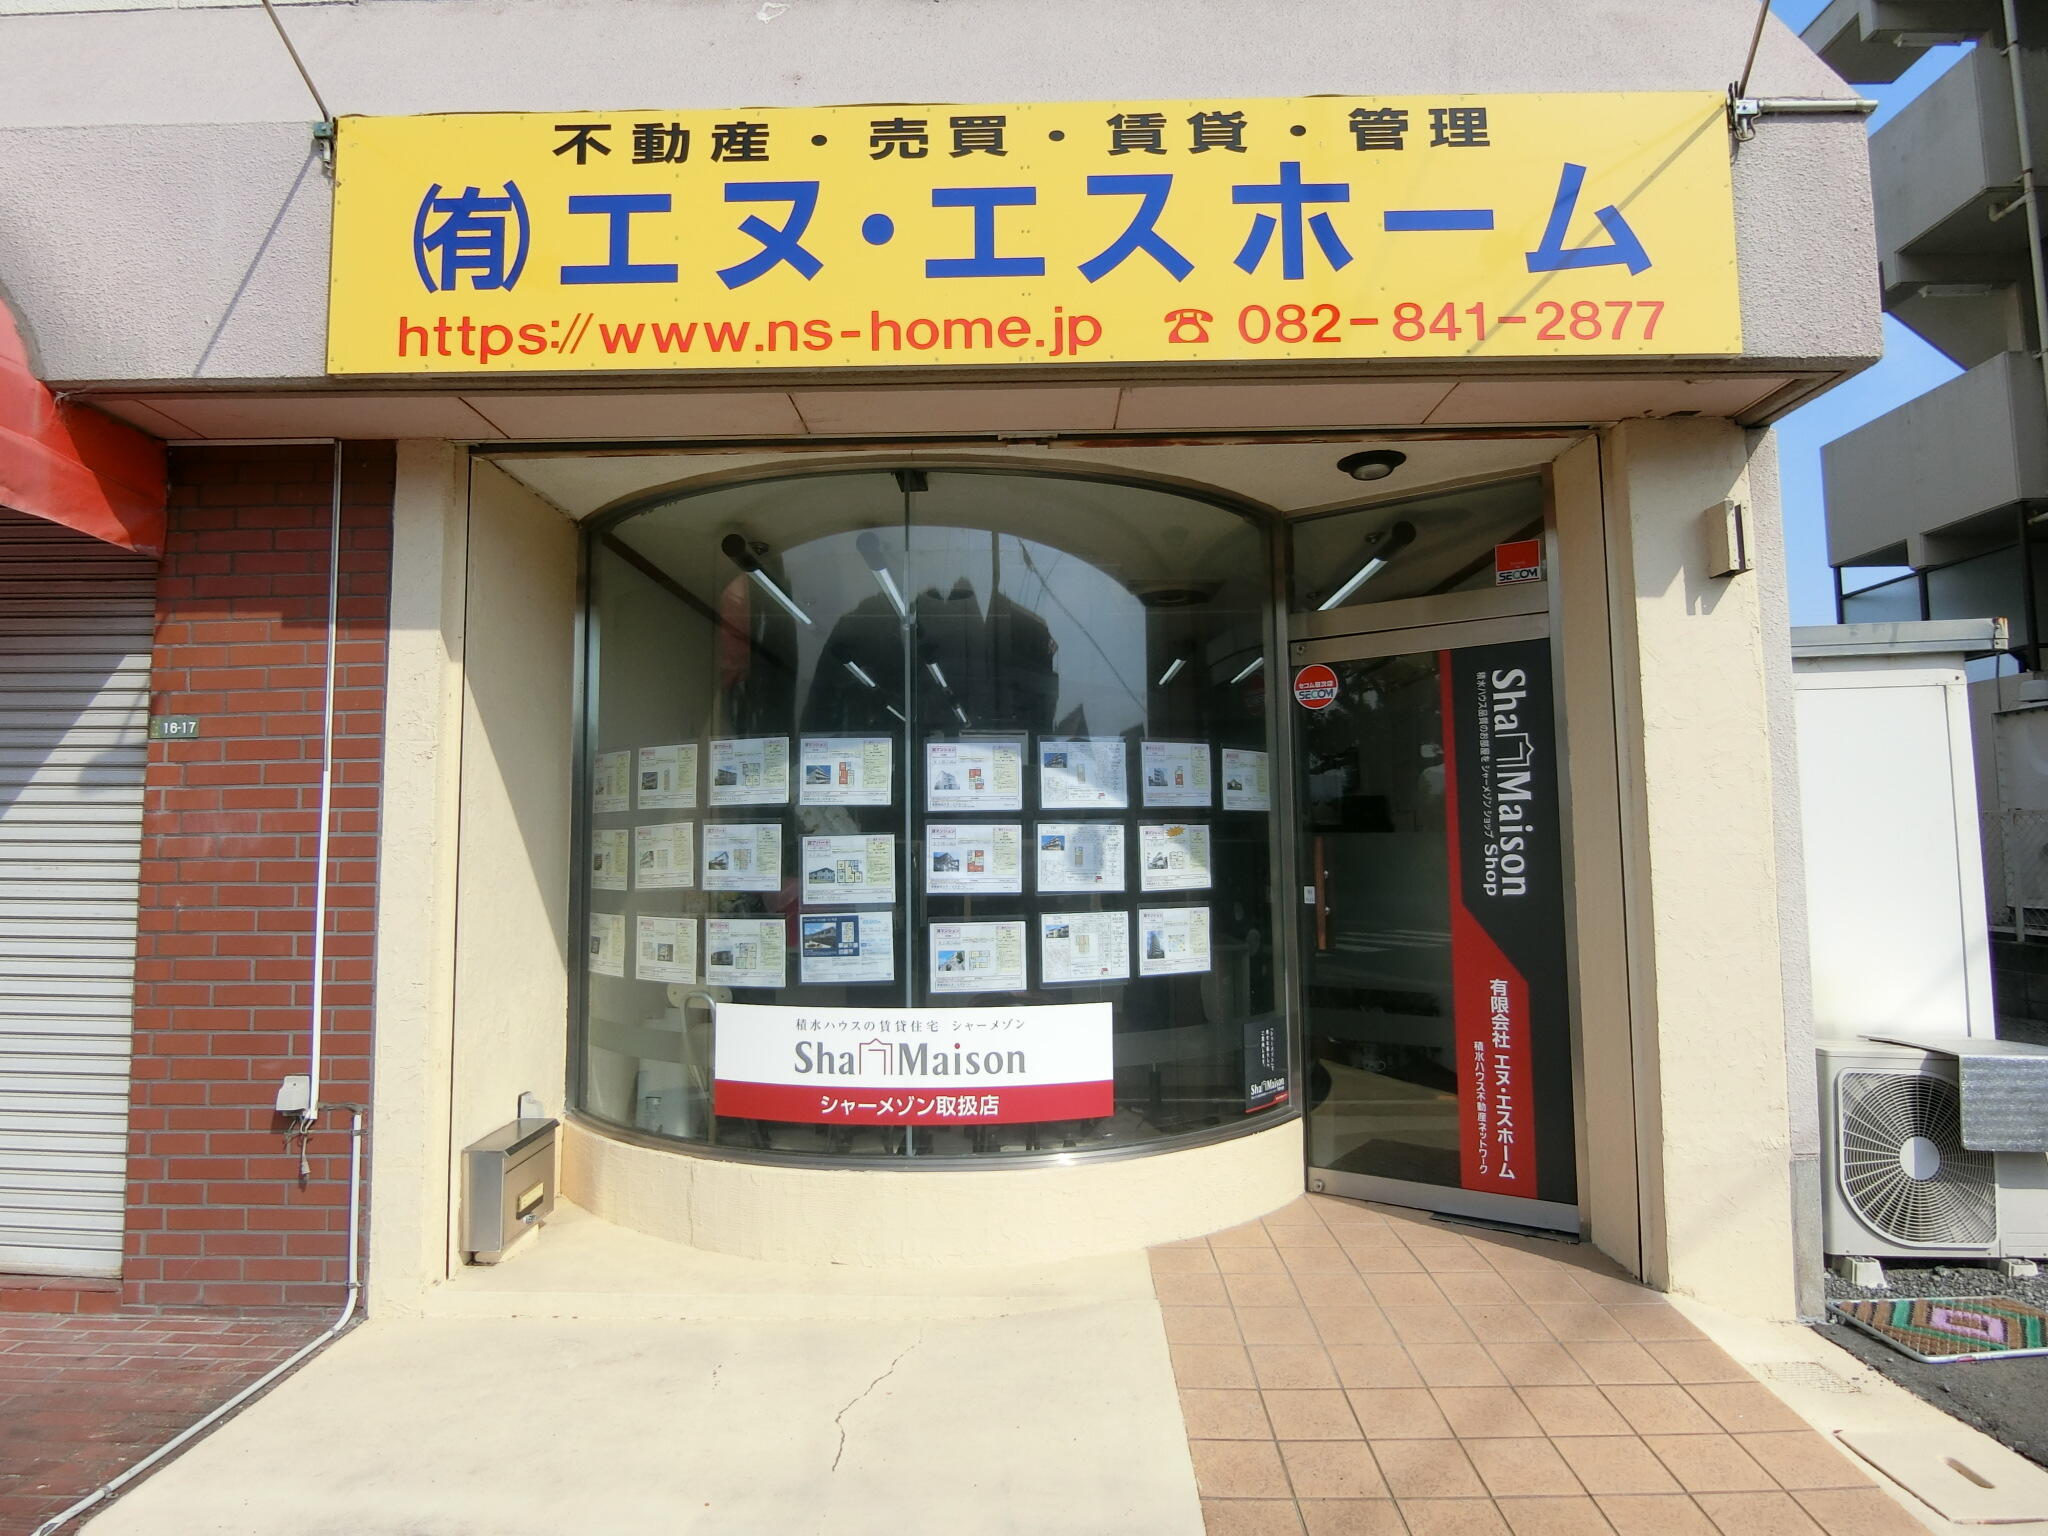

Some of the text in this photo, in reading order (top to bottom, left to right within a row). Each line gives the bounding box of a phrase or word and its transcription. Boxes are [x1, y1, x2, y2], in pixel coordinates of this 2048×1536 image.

[398, 305, 1102, 364] https://www.ns-home.jp
[1237, 300, 1665, 345] 082-841-2877
[1499, 568, 1538, 582] SECOM
[1298, 688, 1334, 700] SECOM
[163, 721, 196, 734] 16-17
[1482, 843, 1499, 896] Shop
[796, 1017, 1025, 1033] 積水ハウスの賃貸住宅 シャーメゾン
[1489, 978, 1516, 1180] 有限会社 エヌ・エスホーム
[820, 1095, 1000, 1117] シャーメゾン取扱店
[1473, 1041, 1488, 1175] 積水ハウス不動産ネットワーク
